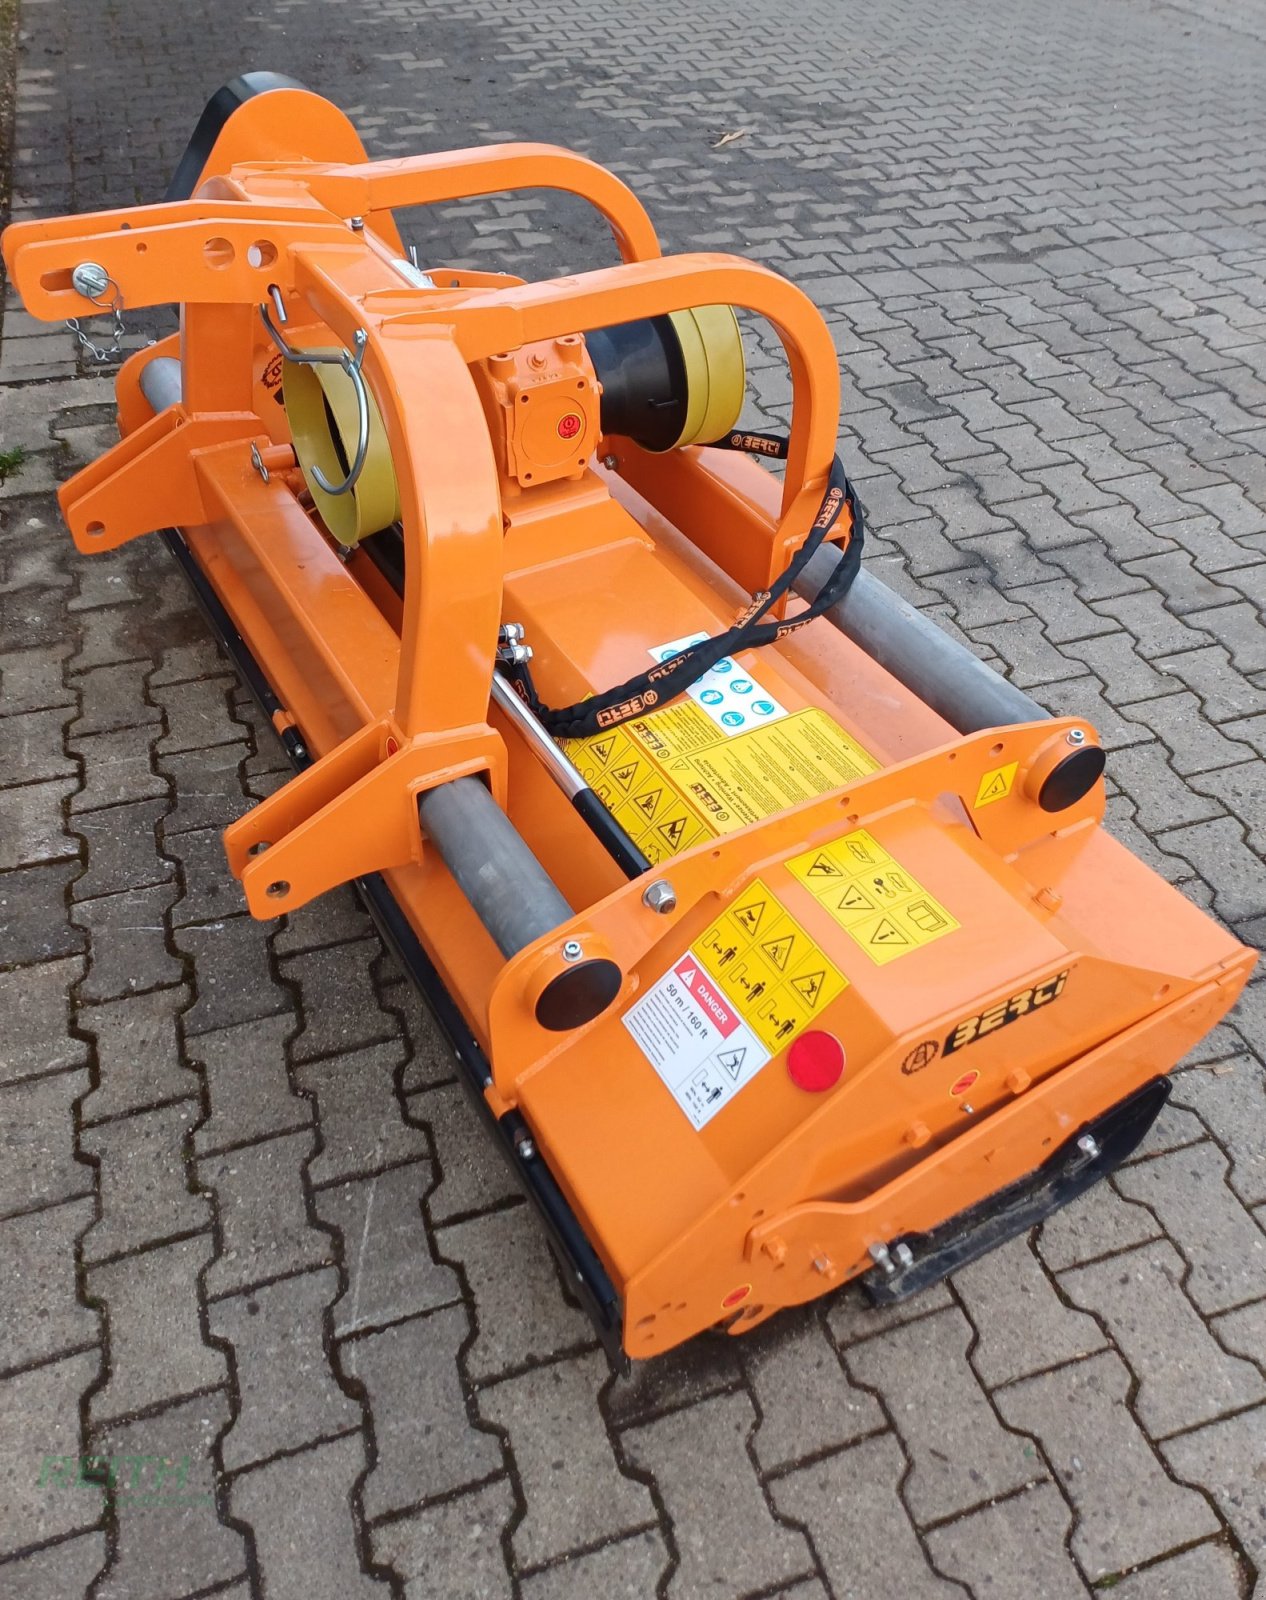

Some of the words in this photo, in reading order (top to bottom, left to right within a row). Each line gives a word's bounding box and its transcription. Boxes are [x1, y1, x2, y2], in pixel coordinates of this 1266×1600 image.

[666, 984, 678, 998] 50
[687, 1011, 702, 1030] 160
[697, 984, 728, 1024] DANGER
